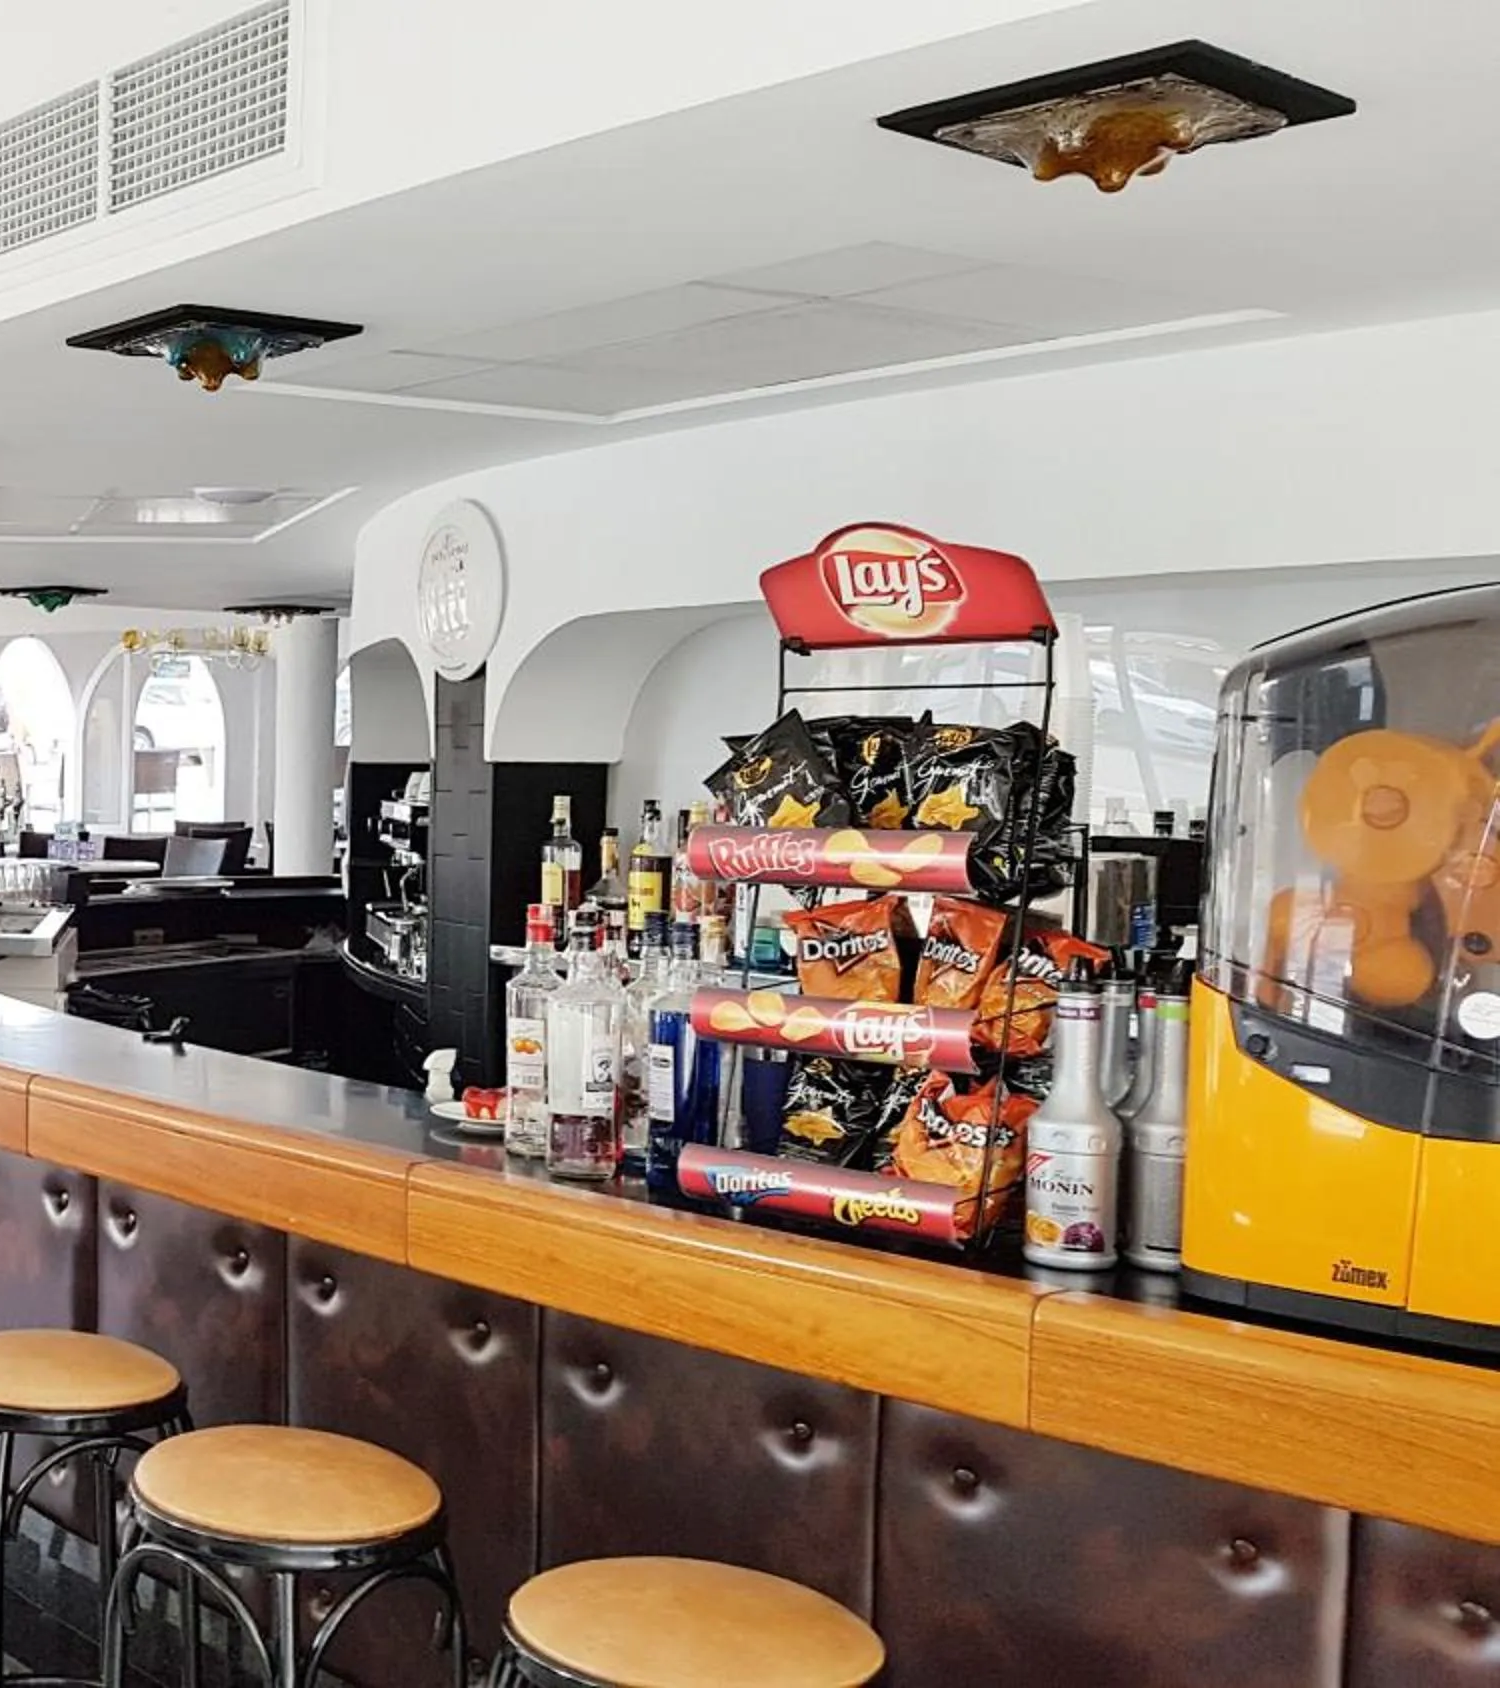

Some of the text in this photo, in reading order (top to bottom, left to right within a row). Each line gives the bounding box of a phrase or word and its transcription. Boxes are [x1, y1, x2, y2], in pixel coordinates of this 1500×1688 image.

[833, 549, 948, 617] Lay's
[709, 831, 816, 881] Ruffles
[802, 928, 889, 961] Doritos
[924, 935, 981, 974] Doritos
[844, 1009, 928, 1061] Lay's
[715, 1167, 793, 1193] Doritos
[1029, 1176, 1095, 1196] MONIN
[833, 1187, 920, 1226] Cheetos
